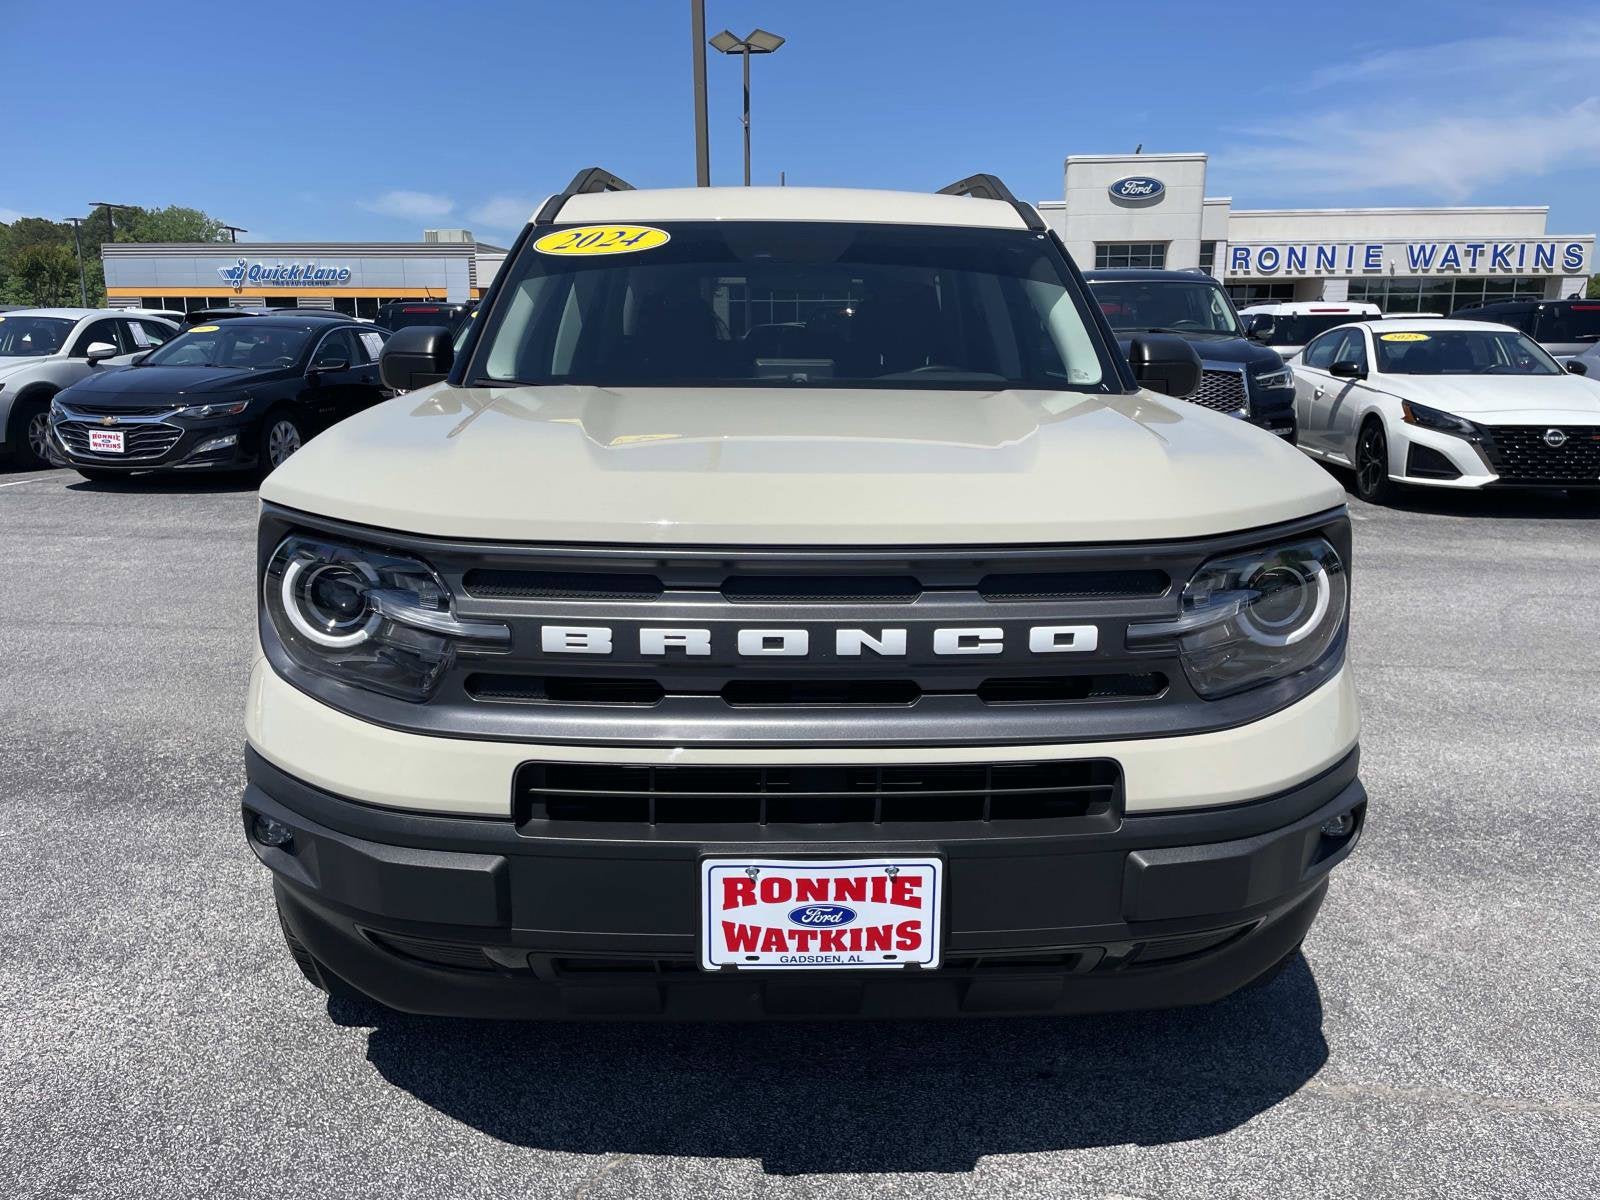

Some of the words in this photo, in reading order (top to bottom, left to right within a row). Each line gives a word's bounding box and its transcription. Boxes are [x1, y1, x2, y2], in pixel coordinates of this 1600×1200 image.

[1121, 180, 1153, 194] Ford
[551, 230, 651, 250] 2024
[1230, 244, 1384, 271] RONNIE
[1408, 242, 1585, 270] WATKINS
[247, 263, 300, 281] Quick
[302, 264, 349, 280] Lane
[541, 625, 1099, 656] BRONCO
[722, 876, 923, 910] RONNIE
[801, 907, 844, 924] Ford
[721, 920, 923, 953] WATKINS
[780, 955, 844, 965] GADSDEN,
[848, 955, 864, 963] AL
